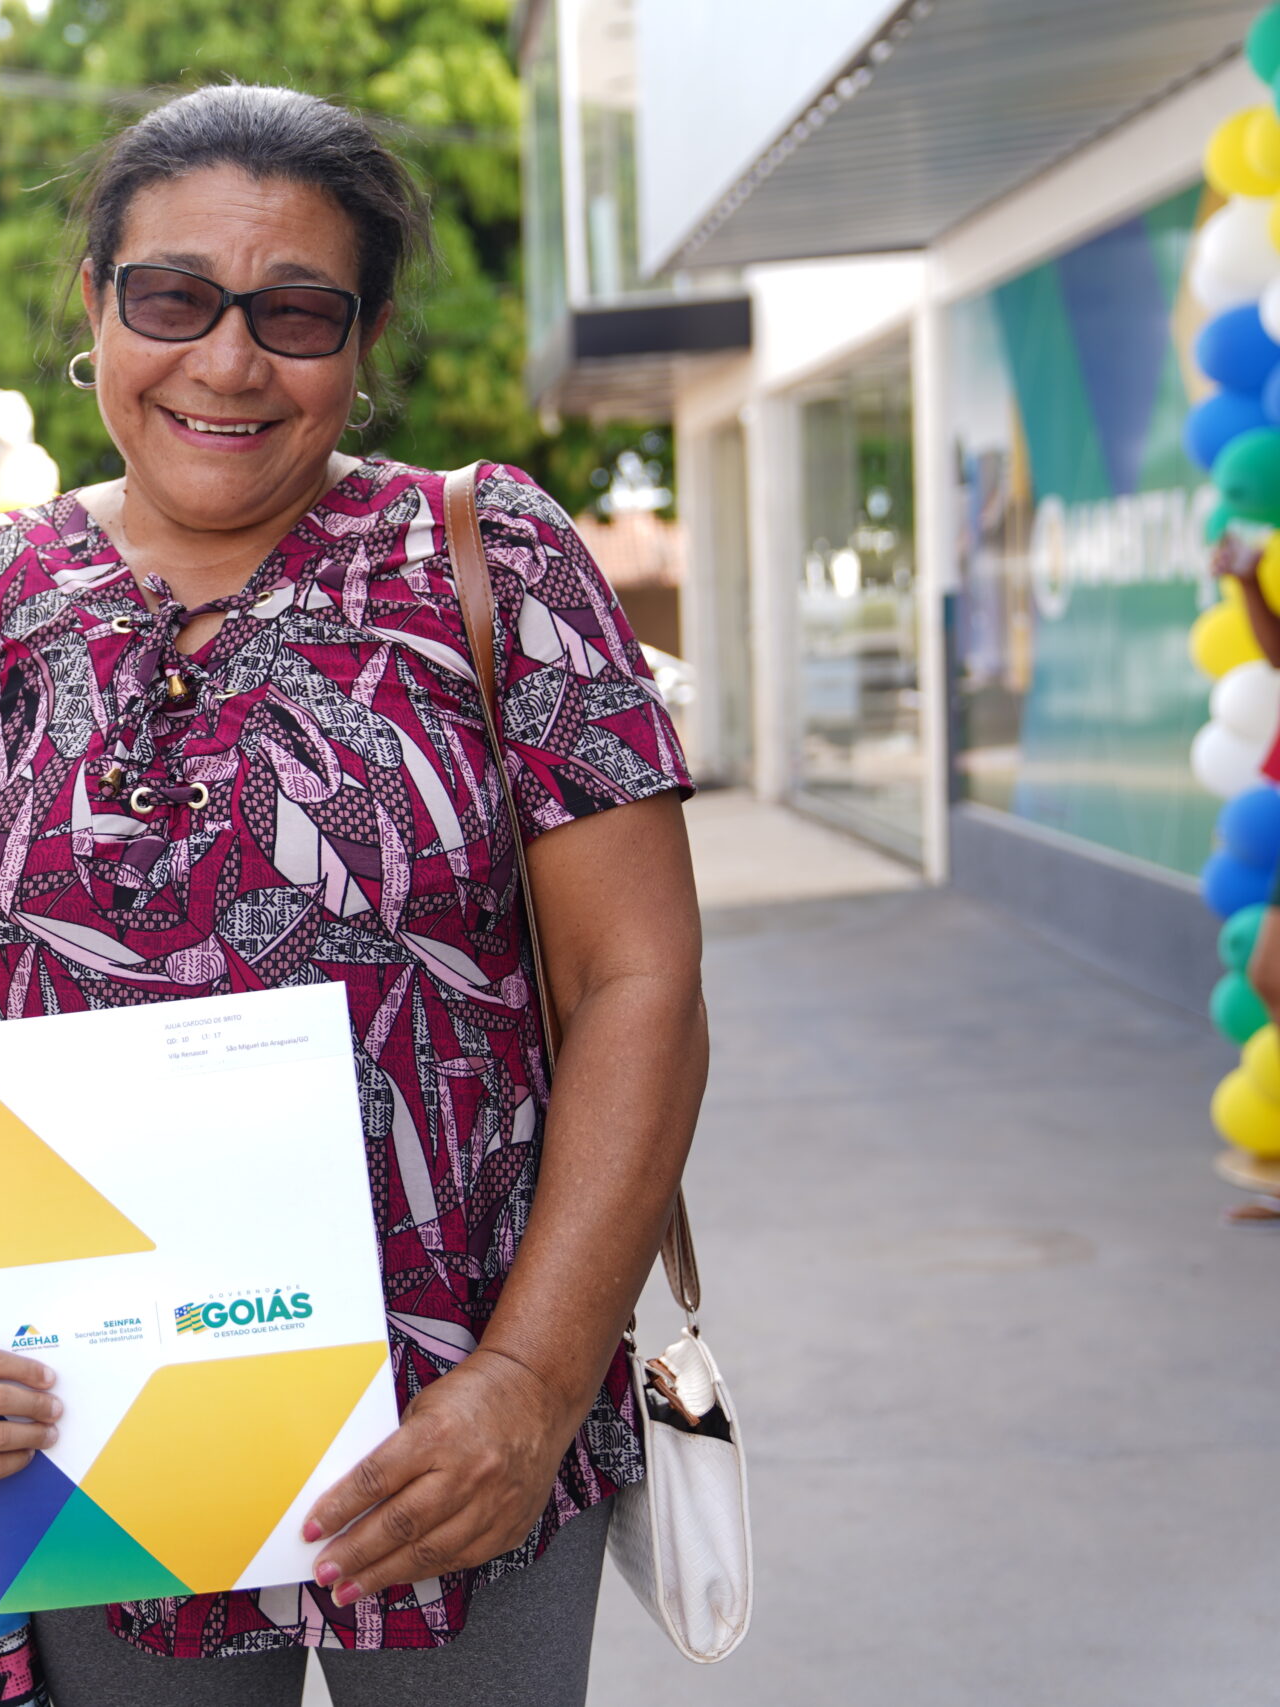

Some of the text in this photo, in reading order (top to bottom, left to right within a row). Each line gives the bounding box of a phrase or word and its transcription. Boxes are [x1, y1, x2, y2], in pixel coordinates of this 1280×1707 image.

[182, 1018, 212, 1028] CARDOSO
[213, 1016, 222, 1024] DE
[223, 1014, 242, 1022] BRITO
[226, 1044, 237, 1052] São
[238, 1041, 260, 1051] Miguel
[208, 1287, 271, 1299] GOVERNO
[201, 1288, 313, 1328] GOIÁS
[103, 1317, 142, 1328] SEINFRA
[74, 1326, 143, 1340] Secretaria de Estado
[221, 1329, 250, 1338] ESTADO
[251, 1326, 267, 1335] QUE
[268, 1324, 279, 1332] DÁ
[281, 1322, 305, 1331] CERTO
[11, 1334, 59, 1348] AGEHAB
